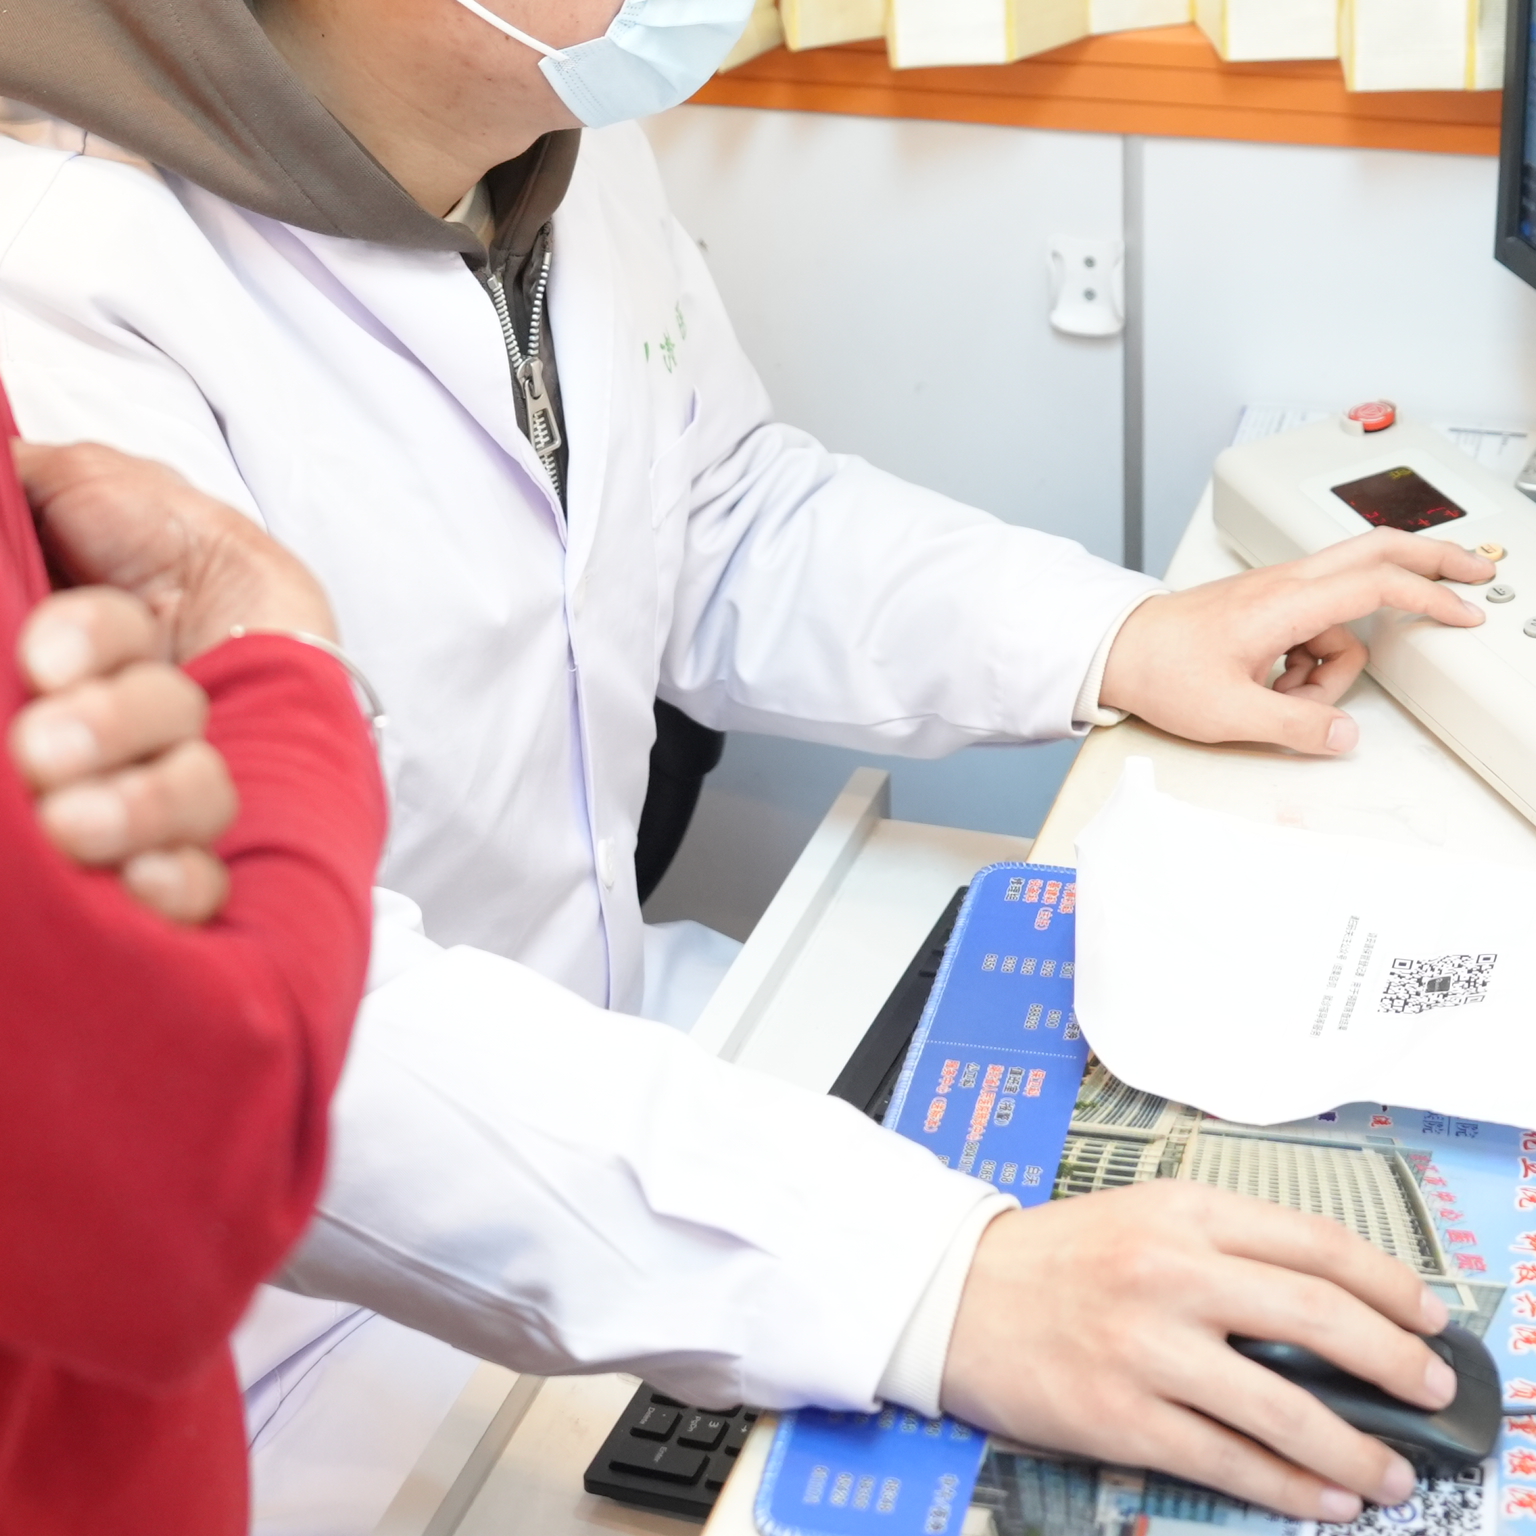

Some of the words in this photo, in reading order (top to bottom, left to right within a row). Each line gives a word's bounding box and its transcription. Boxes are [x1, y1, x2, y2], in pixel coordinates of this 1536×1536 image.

[1004, 877, 1026, 902] 修理组
[981, 953, 999, 971] 8350
[1039, 959, 1056, 978] 8329
[1023, 1003, 1044, 1030] 688329
[1045, 1009, 1062, 1028] 8300
[958, 1062, 981, 1089] 公卫科
[1022, 1068, 1047, 1097] 保卫科
[999, 1161, 1019, 1184] 8358
[1021, 1165, 1044, 1187] 白天
[639, 1406, 655, 1425] Delete
[686, 1415, 701, 1433] PgDn
